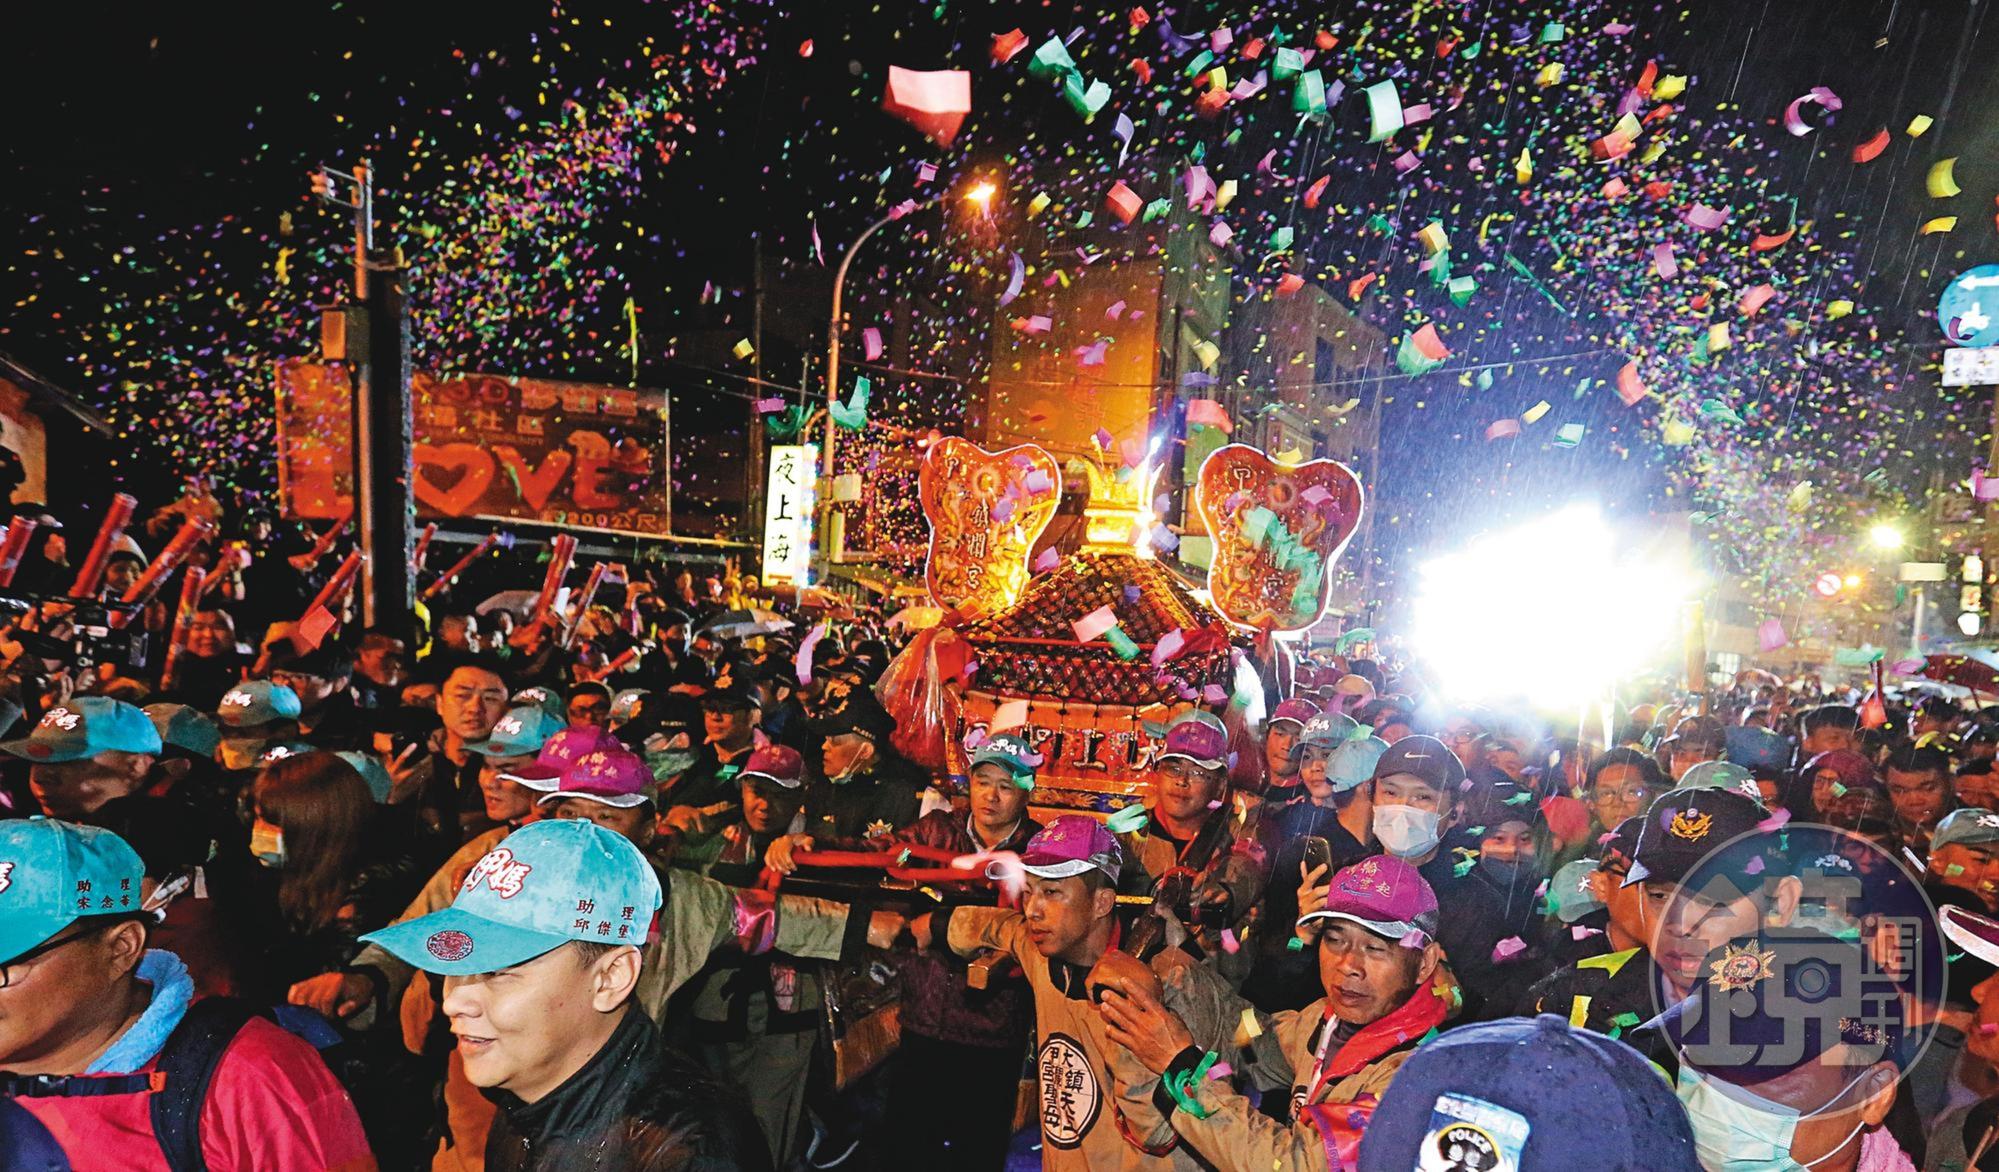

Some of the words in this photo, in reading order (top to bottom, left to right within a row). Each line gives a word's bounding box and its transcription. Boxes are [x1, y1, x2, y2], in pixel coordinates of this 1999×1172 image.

[769, 453, 796, 562] 夜上海
[76, 878, 130, 893] 助理
[575, 898, 635, 921] 助理
[573, 918, 630, 940] 邱傑堡
